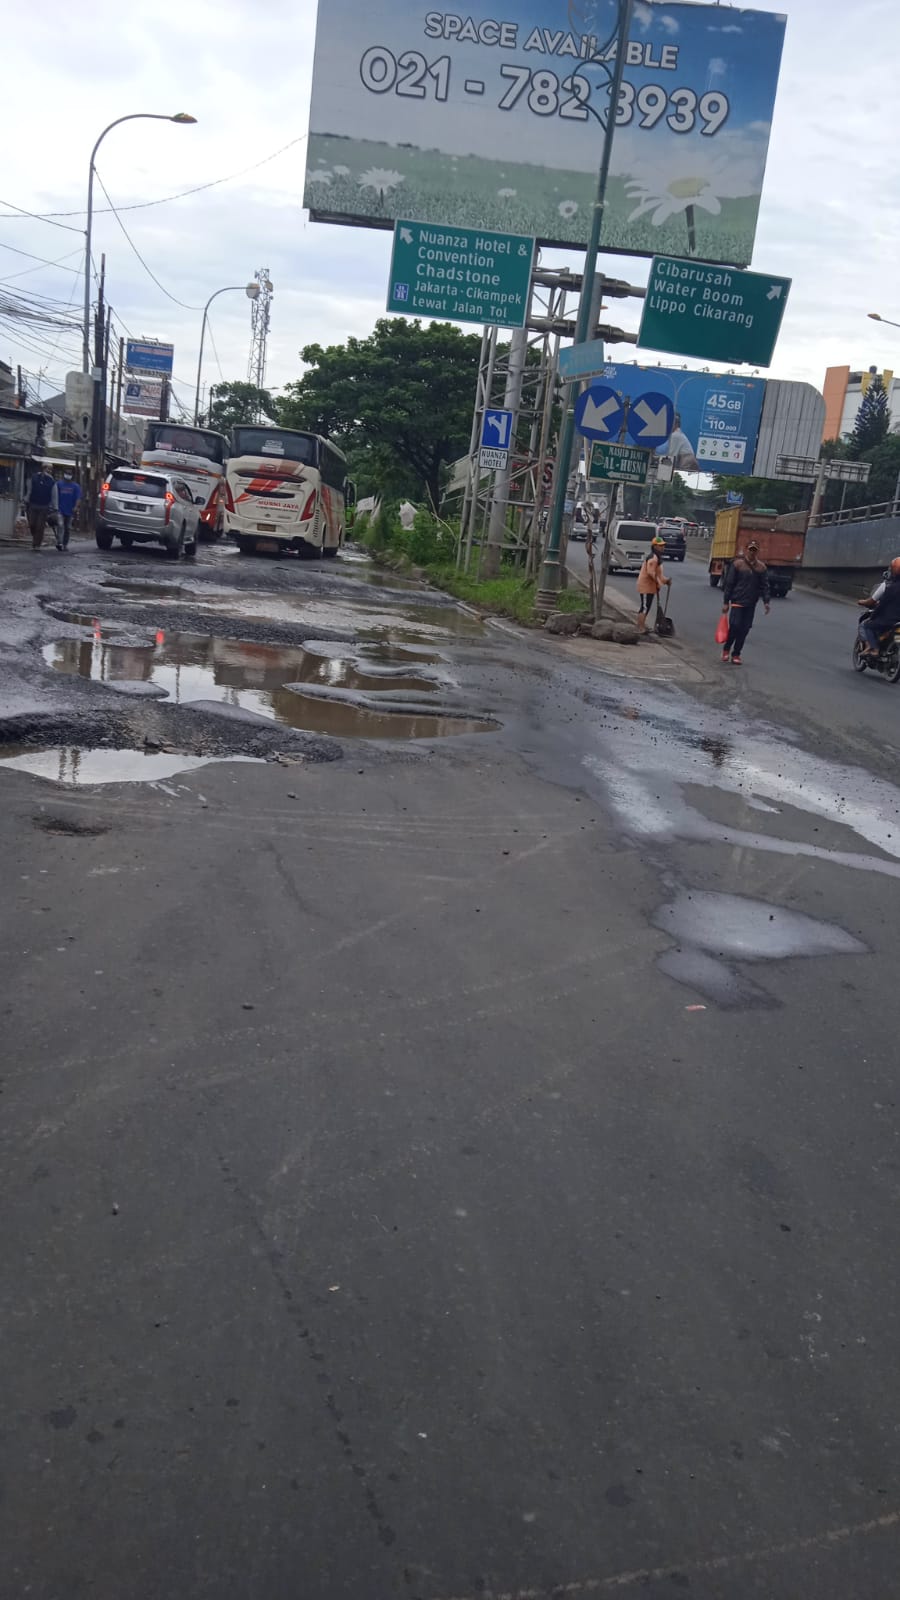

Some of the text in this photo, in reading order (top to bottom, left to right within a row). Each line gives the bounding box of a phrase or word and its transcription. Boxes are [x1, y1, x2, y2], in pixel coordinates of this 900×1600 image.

[424, 11, 680, 71] SPACE AVAILABLE
[359, 45, 451, 101] 021
[419, 230, 528, 257] Nuanza Hotel &
[418, 247, 495, 268] Convention
[416, 263, 501, 285] Chadstone
[656, 262, 732, 287] Cibarusah
[654, 279, 744, 306] Water Boom
[412, 296, 507, 318] Lewat Jalan Tol
[650, 296, 754, 328] Lippo Cikarang
[481, 450, 506, 459] NUANZA
[483, 460, 502, 468] HOTEL
